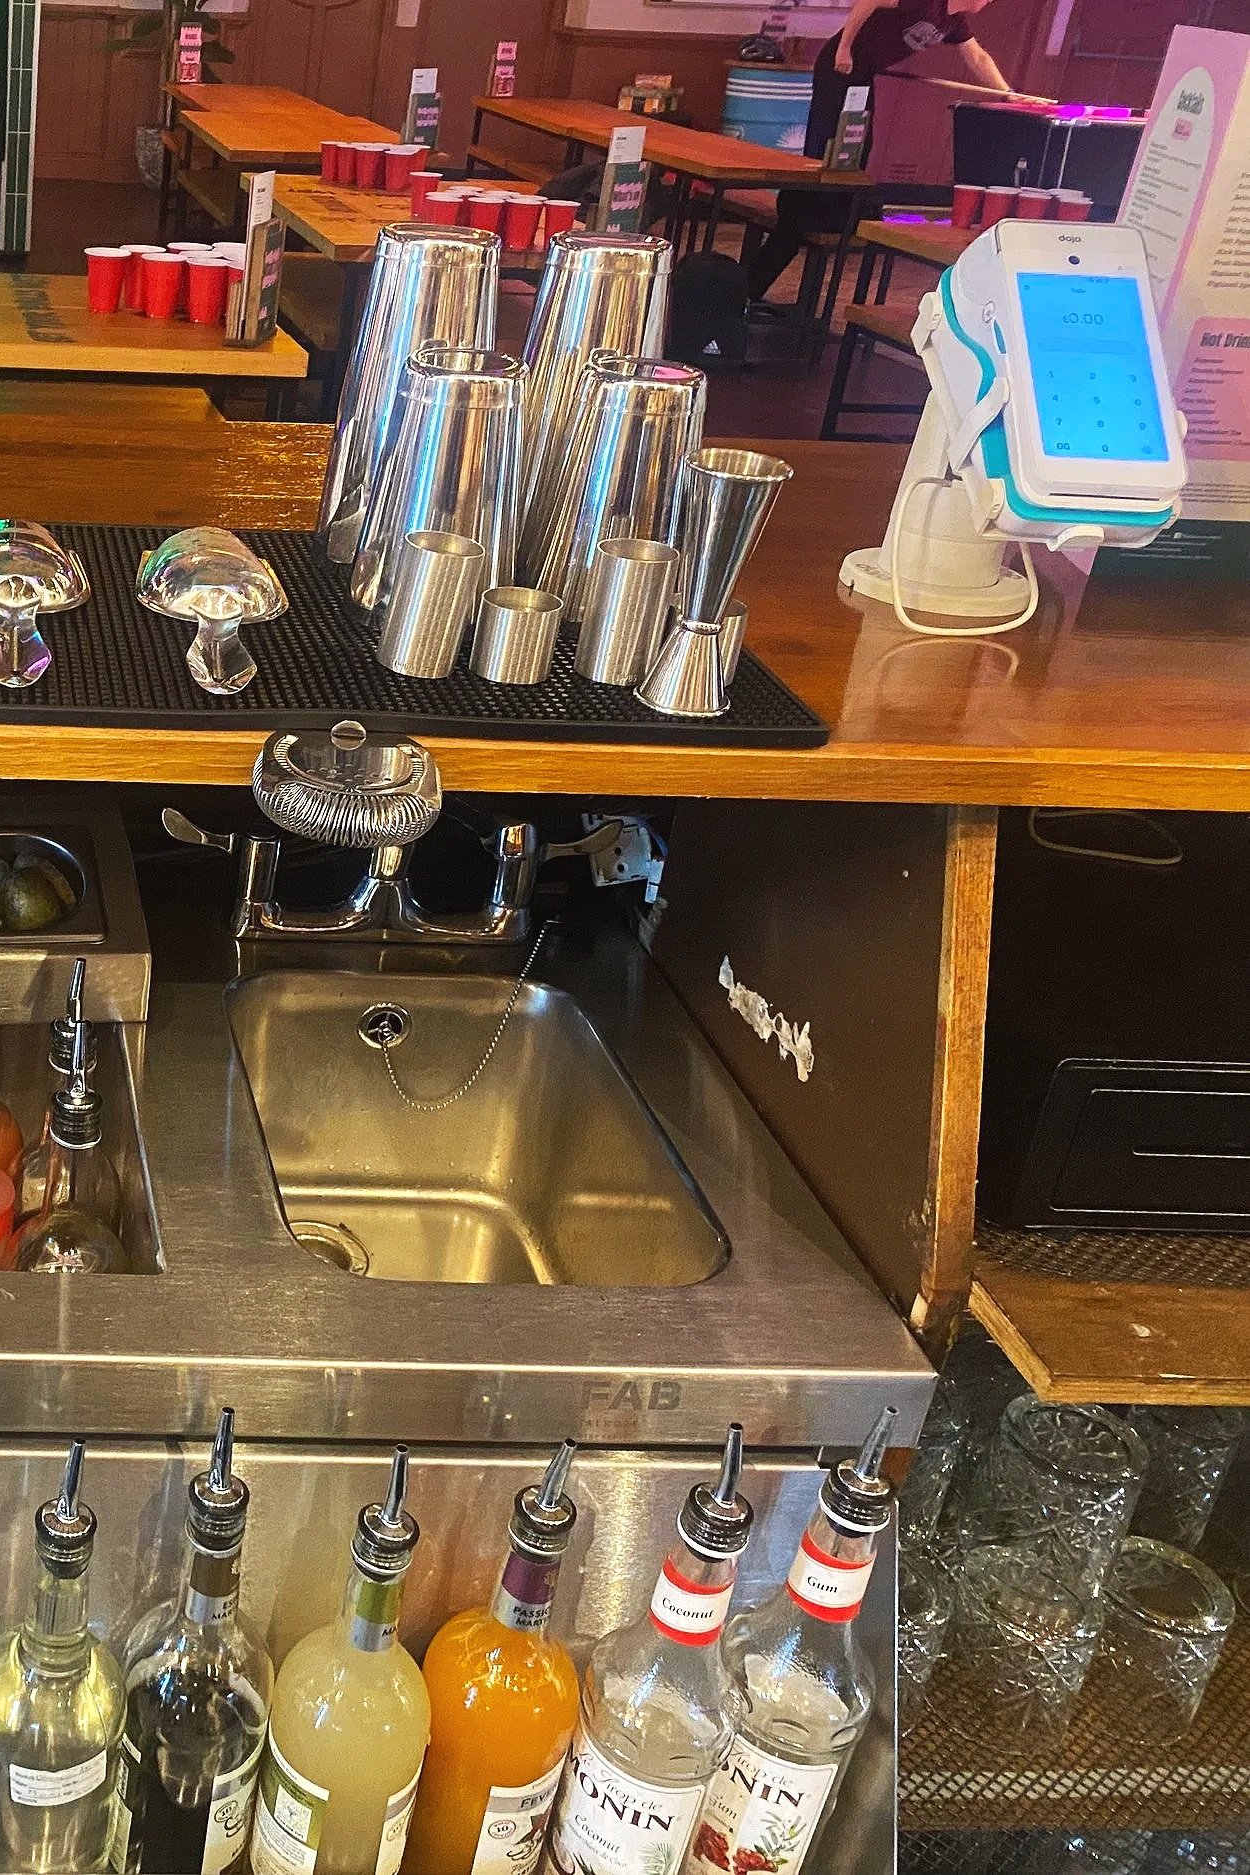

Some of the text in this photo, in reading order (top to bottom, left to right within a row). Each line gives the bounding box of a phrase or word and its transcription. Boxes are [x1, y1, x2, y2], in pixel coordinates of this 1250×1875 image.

[1059, 234, 1081, 243] dojo
[1063, 312, 1104, 326] £0.00
[1200, 332, 1222, 347] Hot
[1056, 442, 1070, 450] 00
[580, 1381, 682, 1410] FAB
[807, 1575, 839, 1594] Gum
[662, 1597, 715, 1620] Coconut
[771, 1772, 794, 1787] de
[642, 1800, 663, 1812] de
[496, 1825, 509, 1833] 10
[574, 1814, 621, 1854] Coconut
